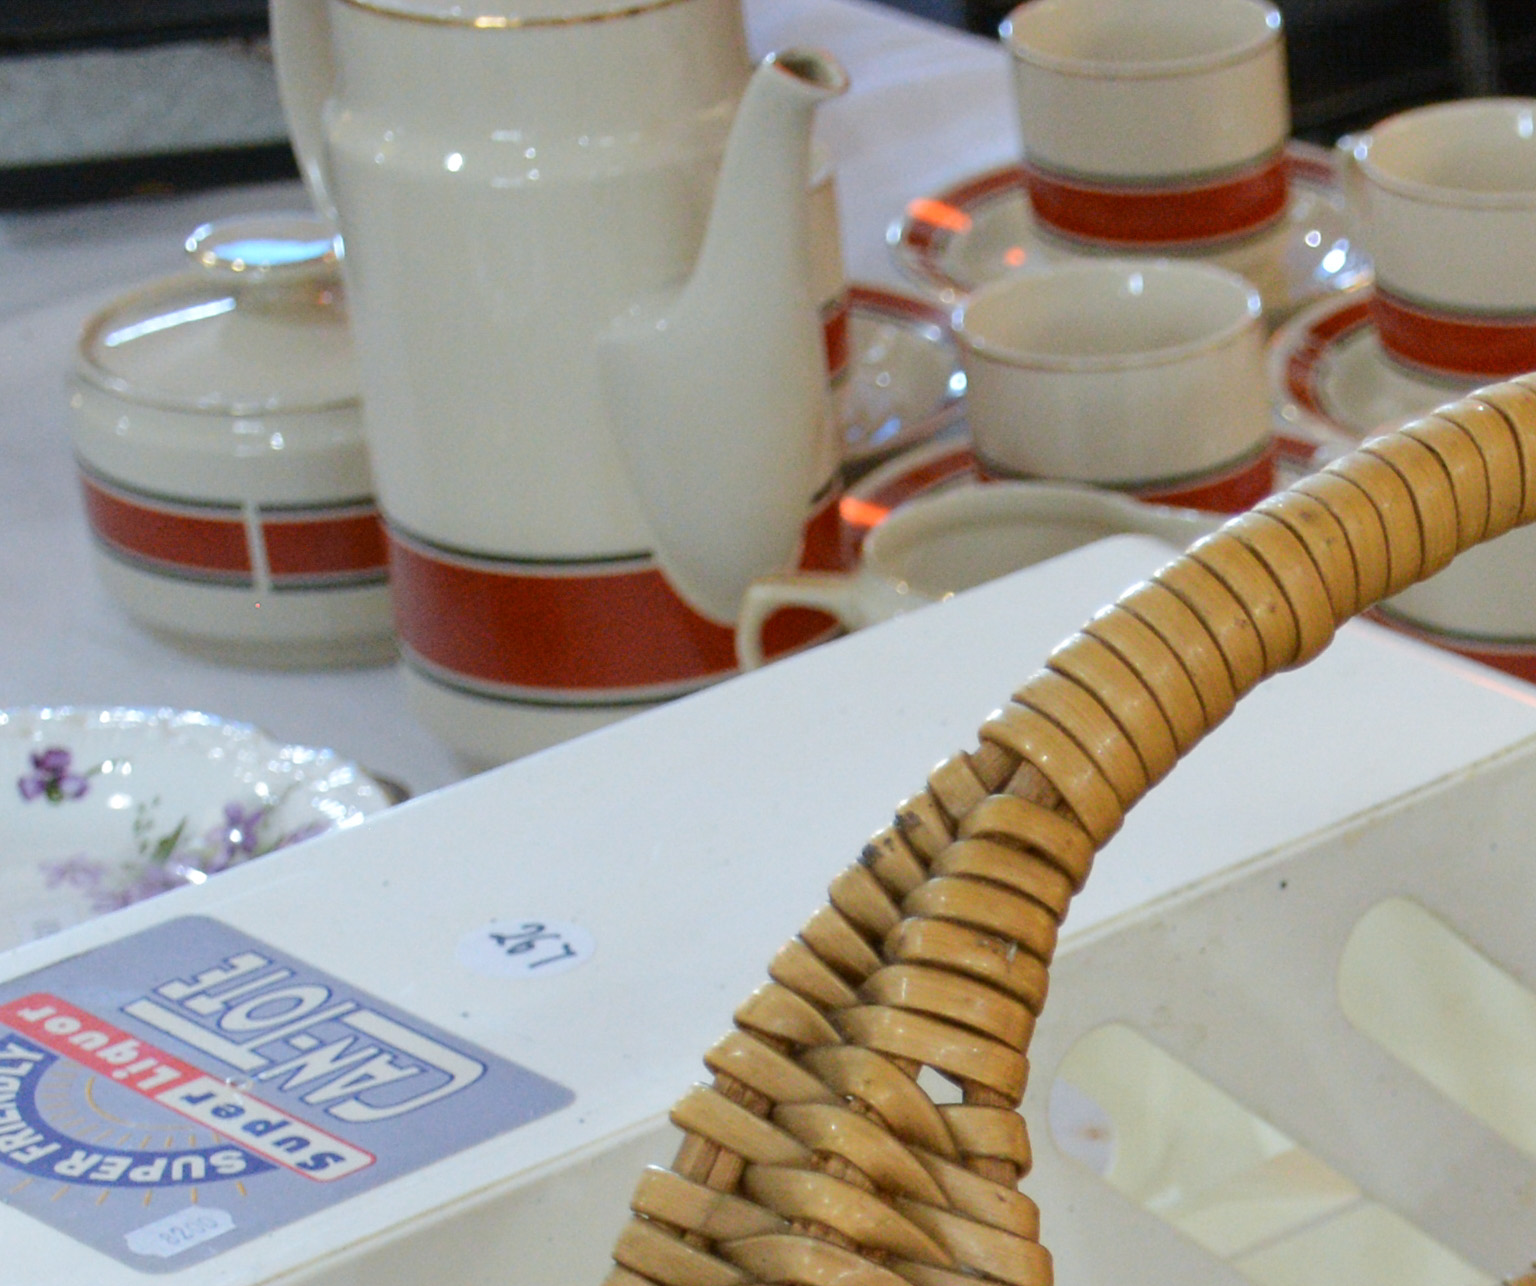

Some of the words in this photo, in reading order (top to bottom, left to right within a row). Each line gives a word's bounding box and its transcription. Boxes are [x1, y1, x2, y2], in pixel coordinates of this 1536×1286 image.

[490, 922, 578, 971] 267
[16, 1004, 184, 1092] Liquor
[180, 1088, 347, 1171] Super
[53, 1148, 248, 1184] SUPER
